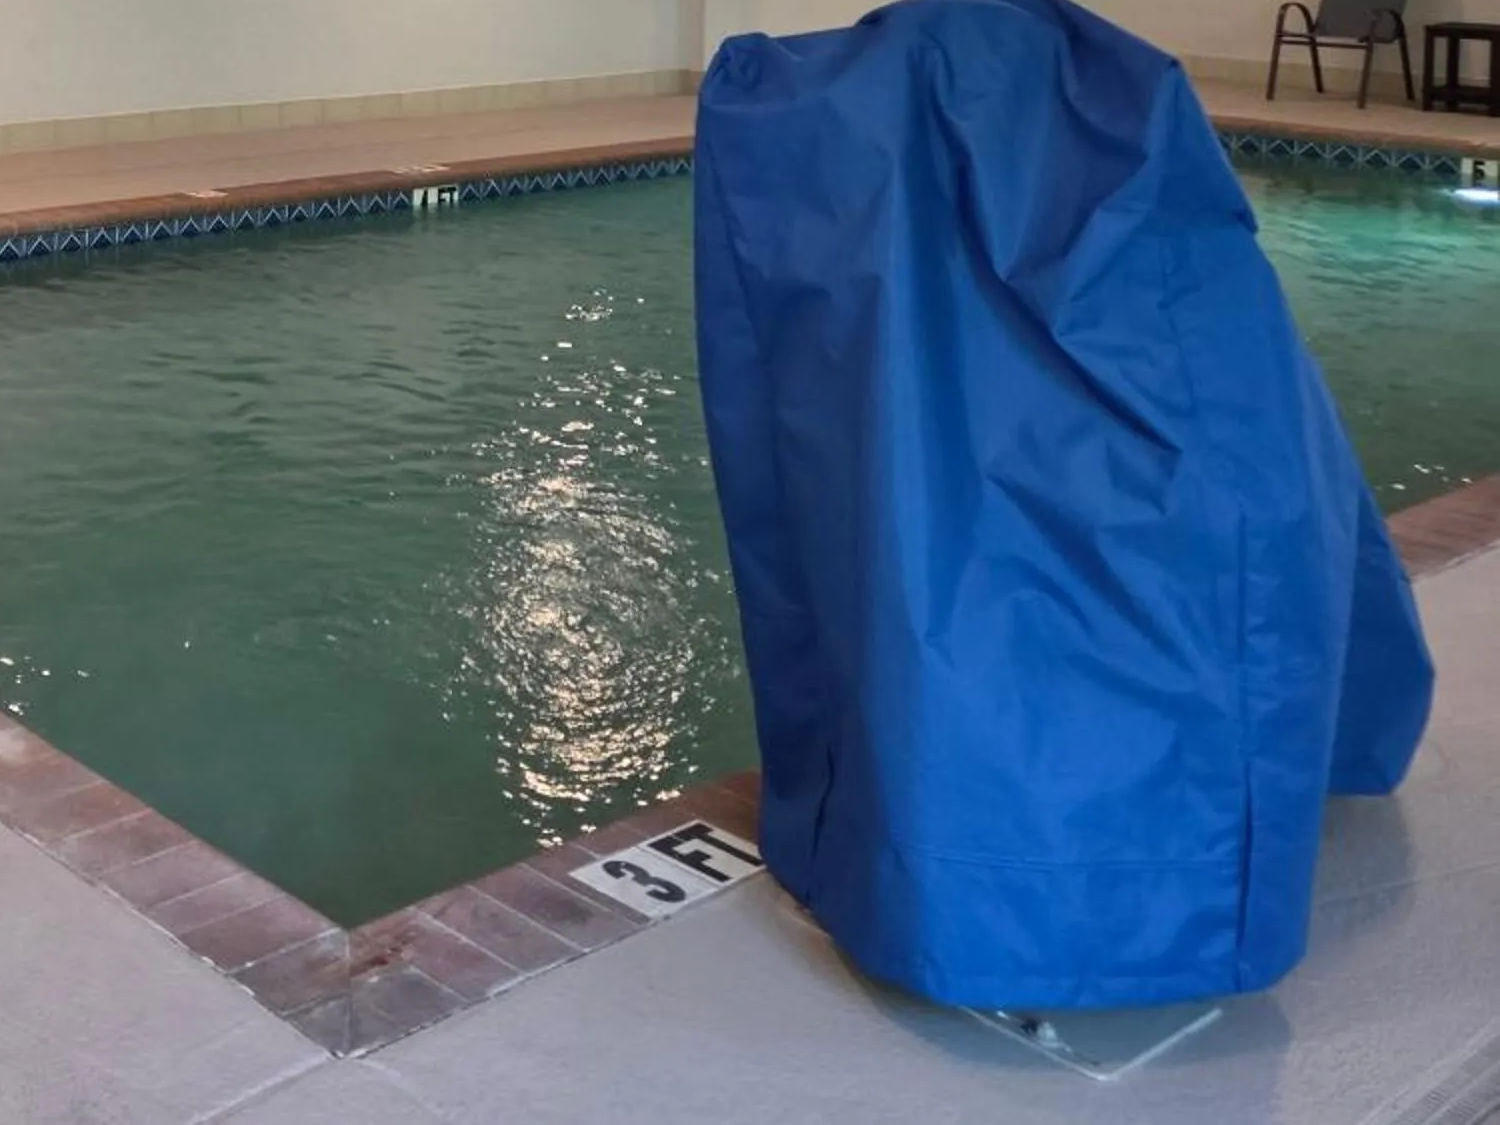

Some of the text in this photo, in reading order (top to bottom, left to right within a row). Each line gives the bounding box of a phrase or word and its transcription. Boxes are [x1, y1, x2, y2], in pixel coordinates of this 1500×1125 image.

[438, 186, 456, 203] FT
[602, 823, 765, 904] 3 FT
